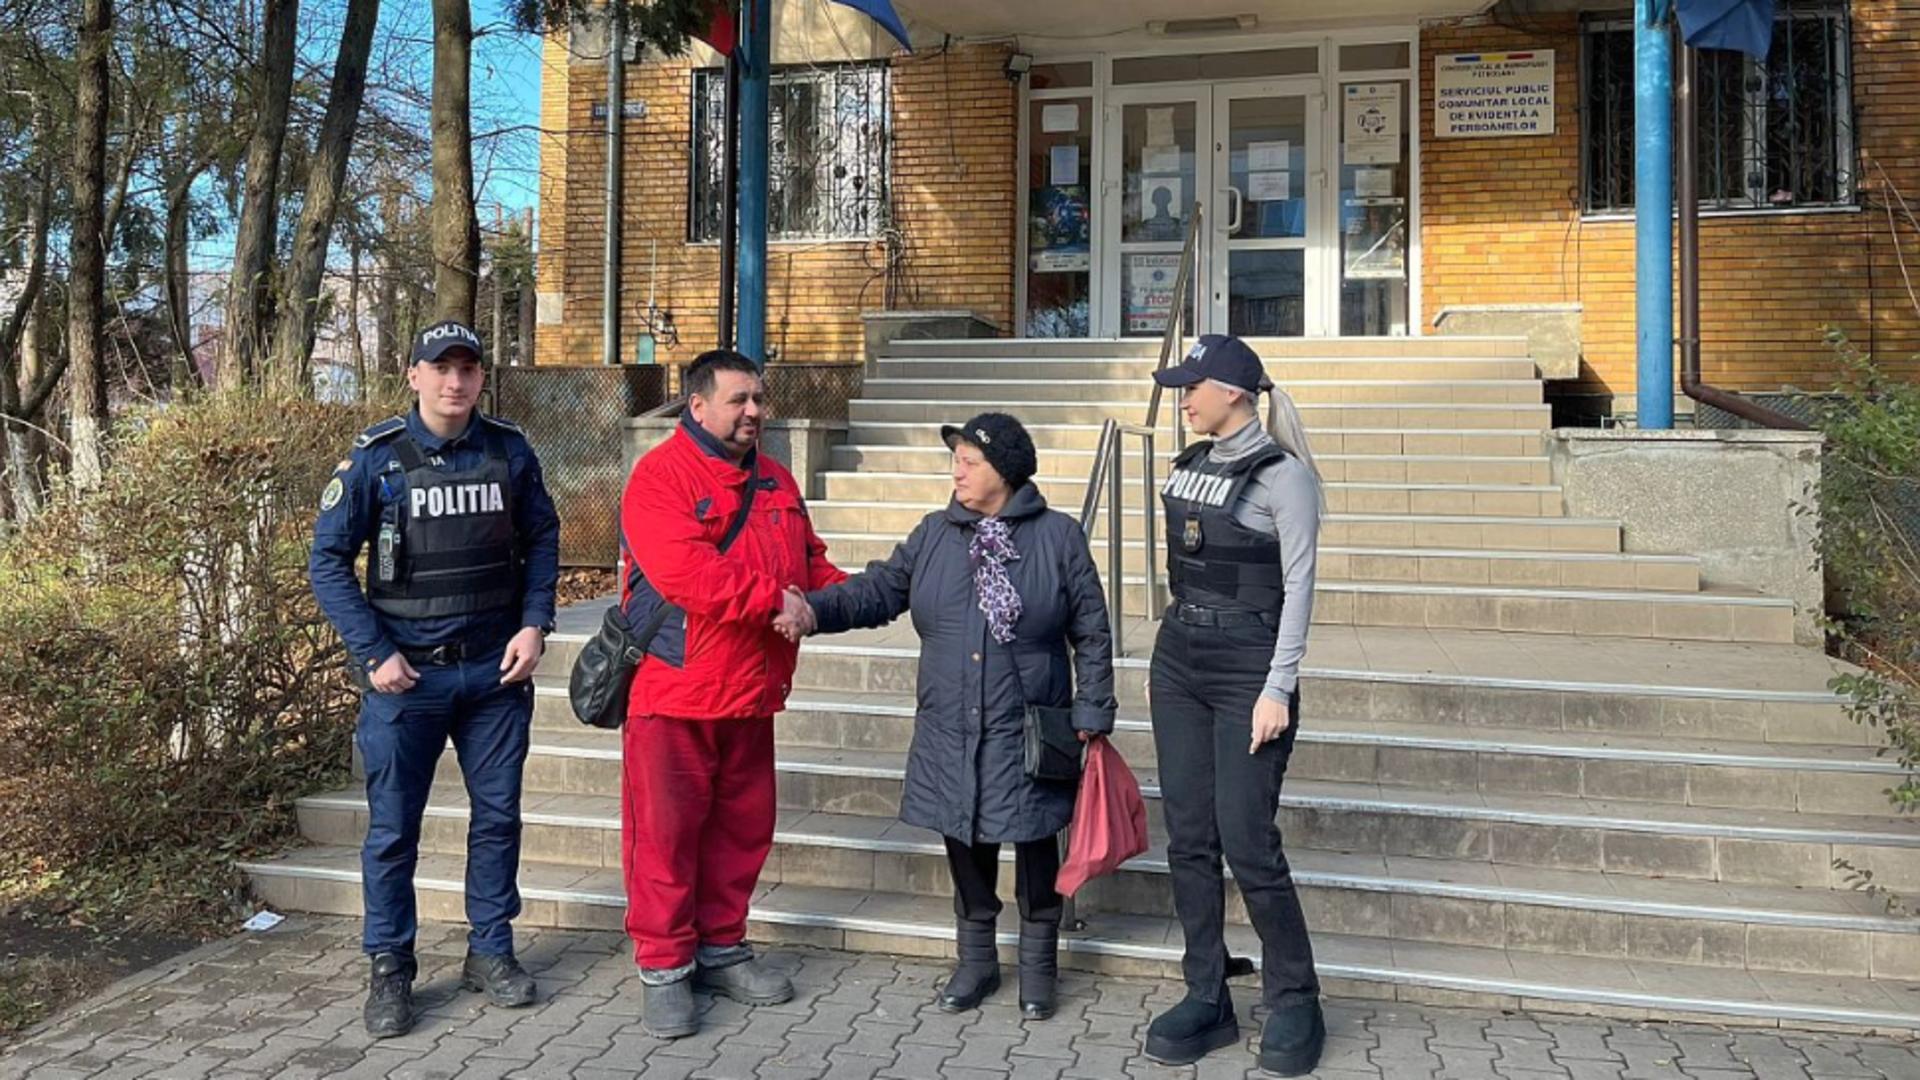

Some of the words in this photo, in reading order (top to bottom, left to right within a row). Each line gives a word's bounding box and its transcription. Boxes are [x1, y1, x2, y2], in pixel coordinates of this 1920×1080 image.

[1440, 86, 1501, 97] SERVICIUL
[1505, 84, 1550, 94] PUBLIC
[1438, 99, 1507, 109] COMUNITAR
[1511, 96, 1551, 106] LOCAL
[1449, 112, 1465, 121] DE
[1530, 110, 1539, 118] A
[1450, 122, 1537, 133] PERSOANELOR
[423, 324, 480, 345] POLITIA
[1162, 469, 1233, 507] POLITIA
[411, 482, 504, 518] POLITIA
